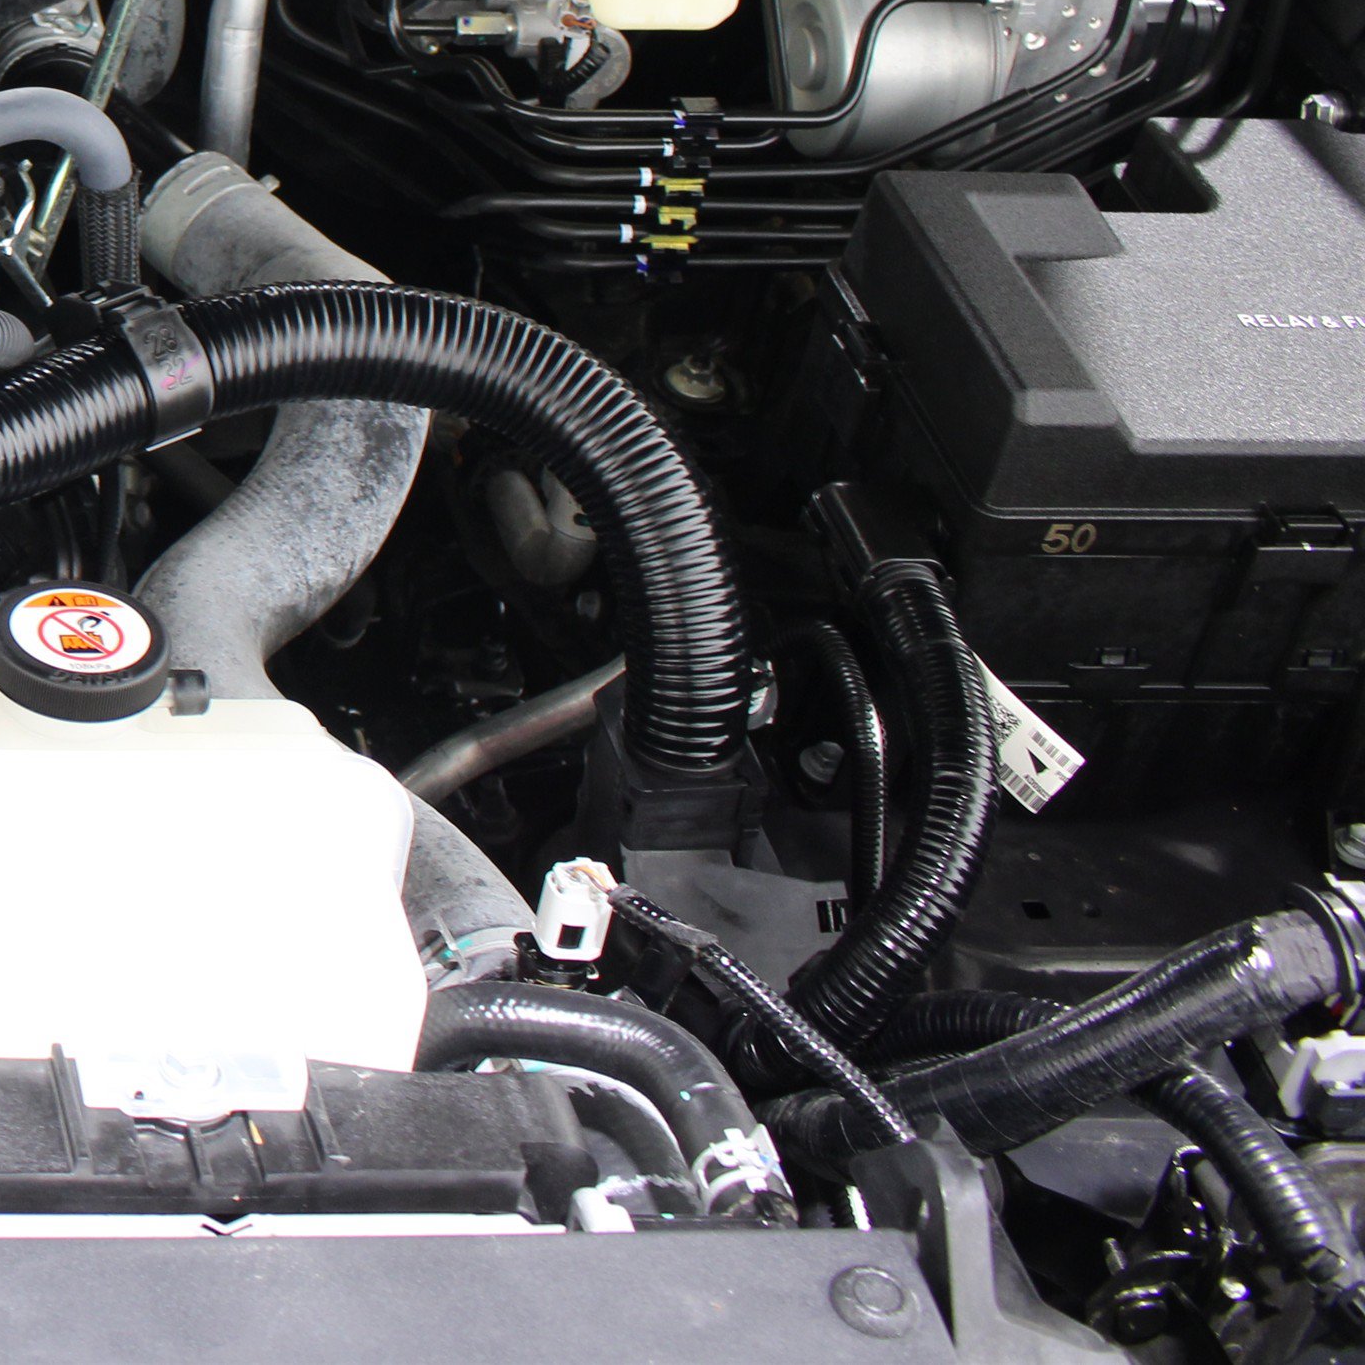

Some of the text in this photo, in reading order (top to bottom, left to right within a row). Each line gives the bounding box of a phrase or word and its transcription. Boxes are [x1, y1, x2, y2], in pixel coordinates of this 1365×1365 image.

[1236, 313, 1317, 329] RELAY
[1320, 315, 1341, 329] &
[1041, 522, 1098, 555] 50
